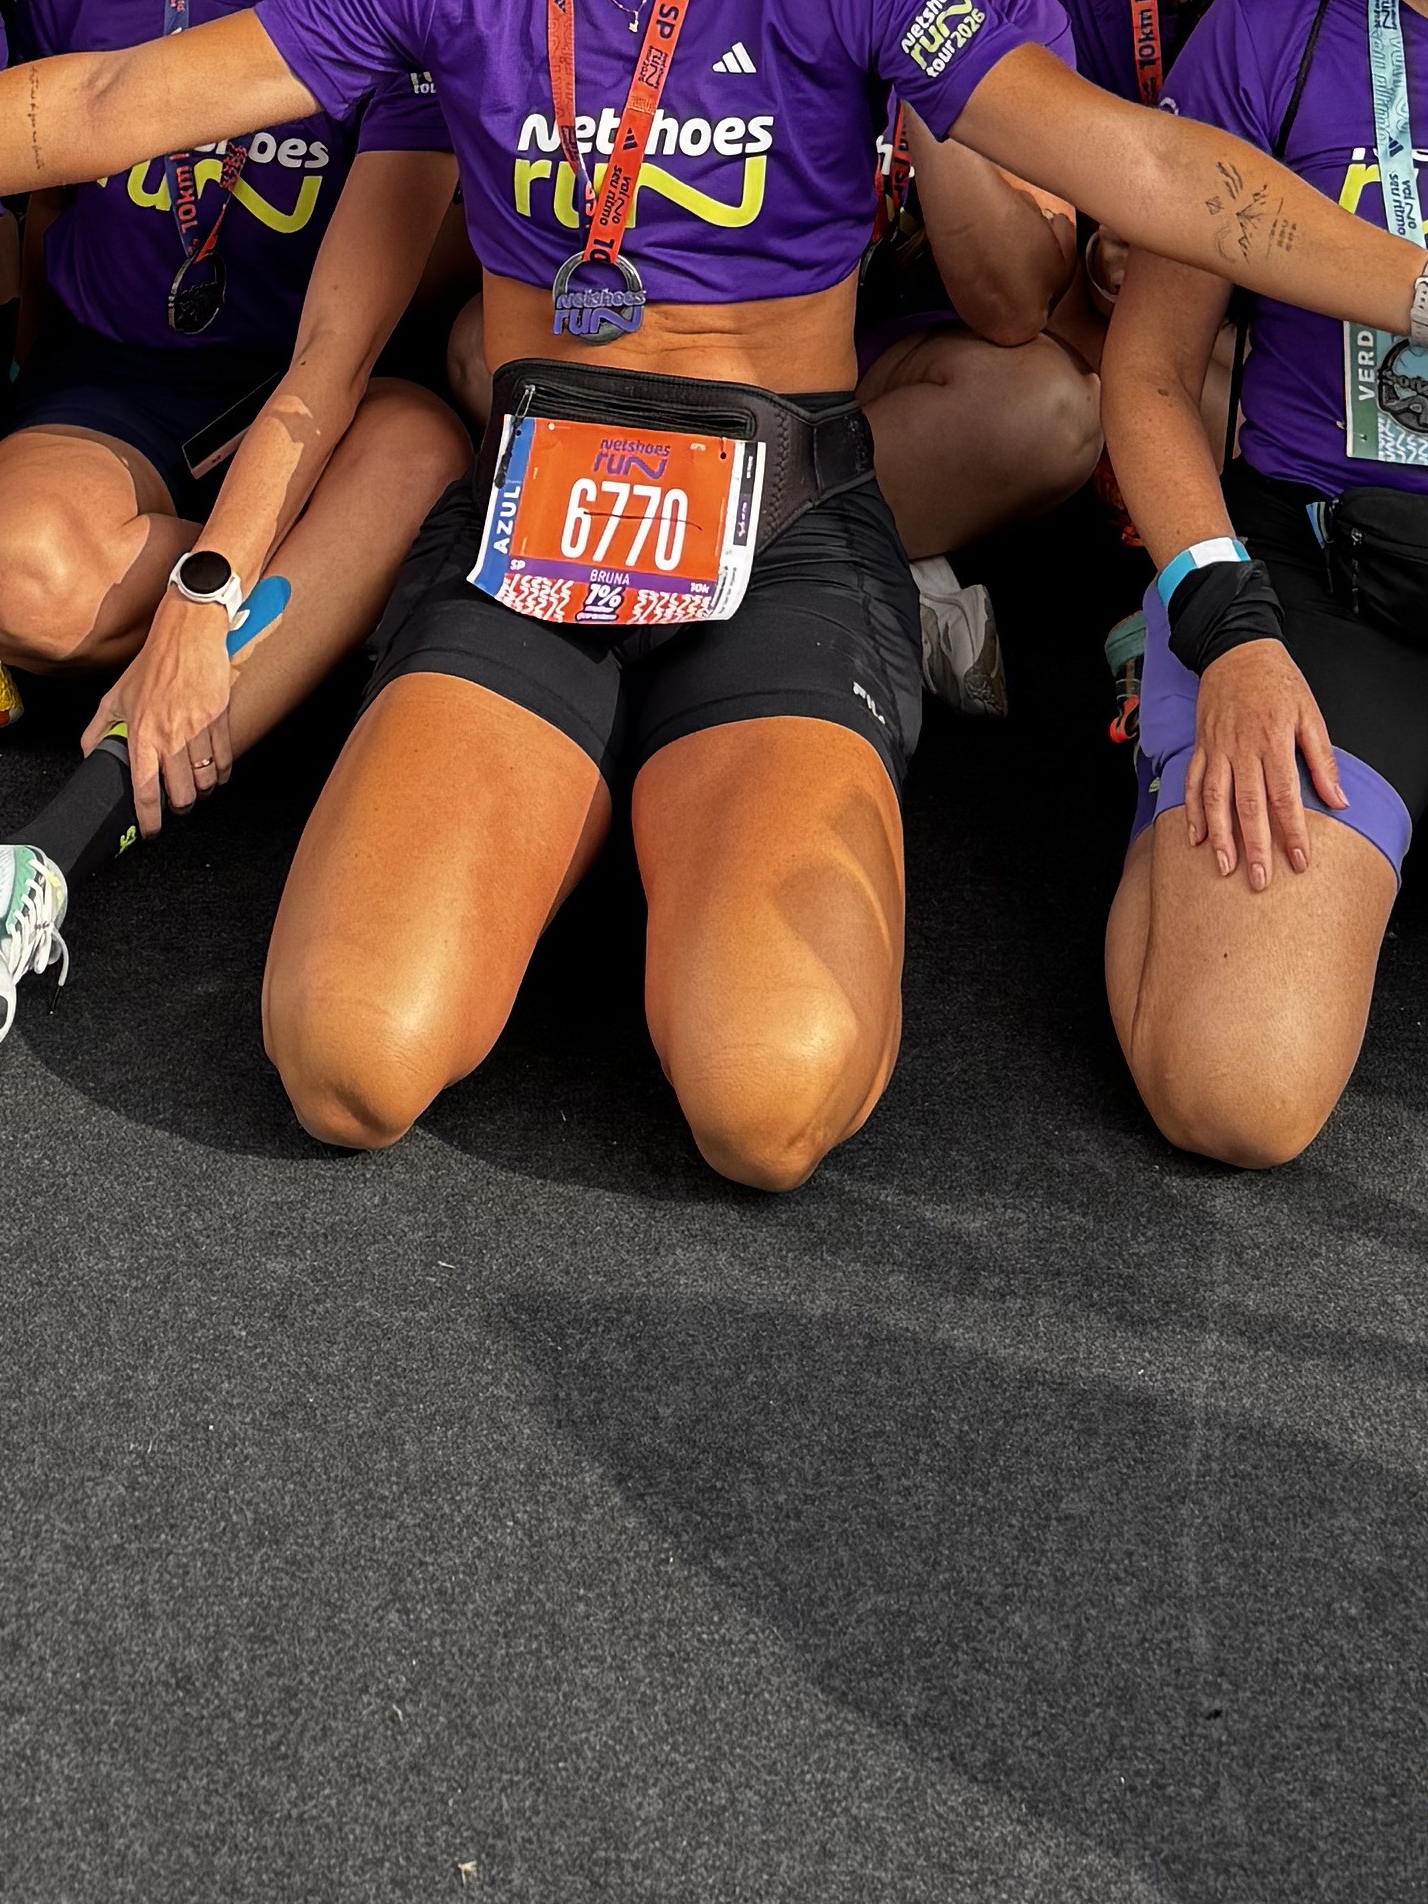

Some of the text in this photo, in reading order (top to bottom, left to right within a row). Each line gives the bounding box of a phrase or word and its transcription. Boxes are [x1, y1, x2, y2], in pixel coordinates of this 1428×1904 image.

[655, 3, 681, 41] SP
[925, 8, 987, 79] tour 2026
[1138, 10, 1156, 70] 10km
[516, 107, 774, 157] Nethoes
[176, 164, 199, 235] 10km
[513, 155, 769, 229] run
[588, 238, 616, 264] 10
[552, 307, 644, 337] run
[556, 290, 647, 310] Netshoes
[1357, 329, 1375, 402] VERD
[592, 451, 668, 480] run
[600, 439, 671, 457] Netshoes
[493, 485, 521, 555] AZUL
[561, 477, 689, 572] 6770
[509, 558, 710, 594] SP BRUNA 10k
[585, 582, 623, 607] 1%
